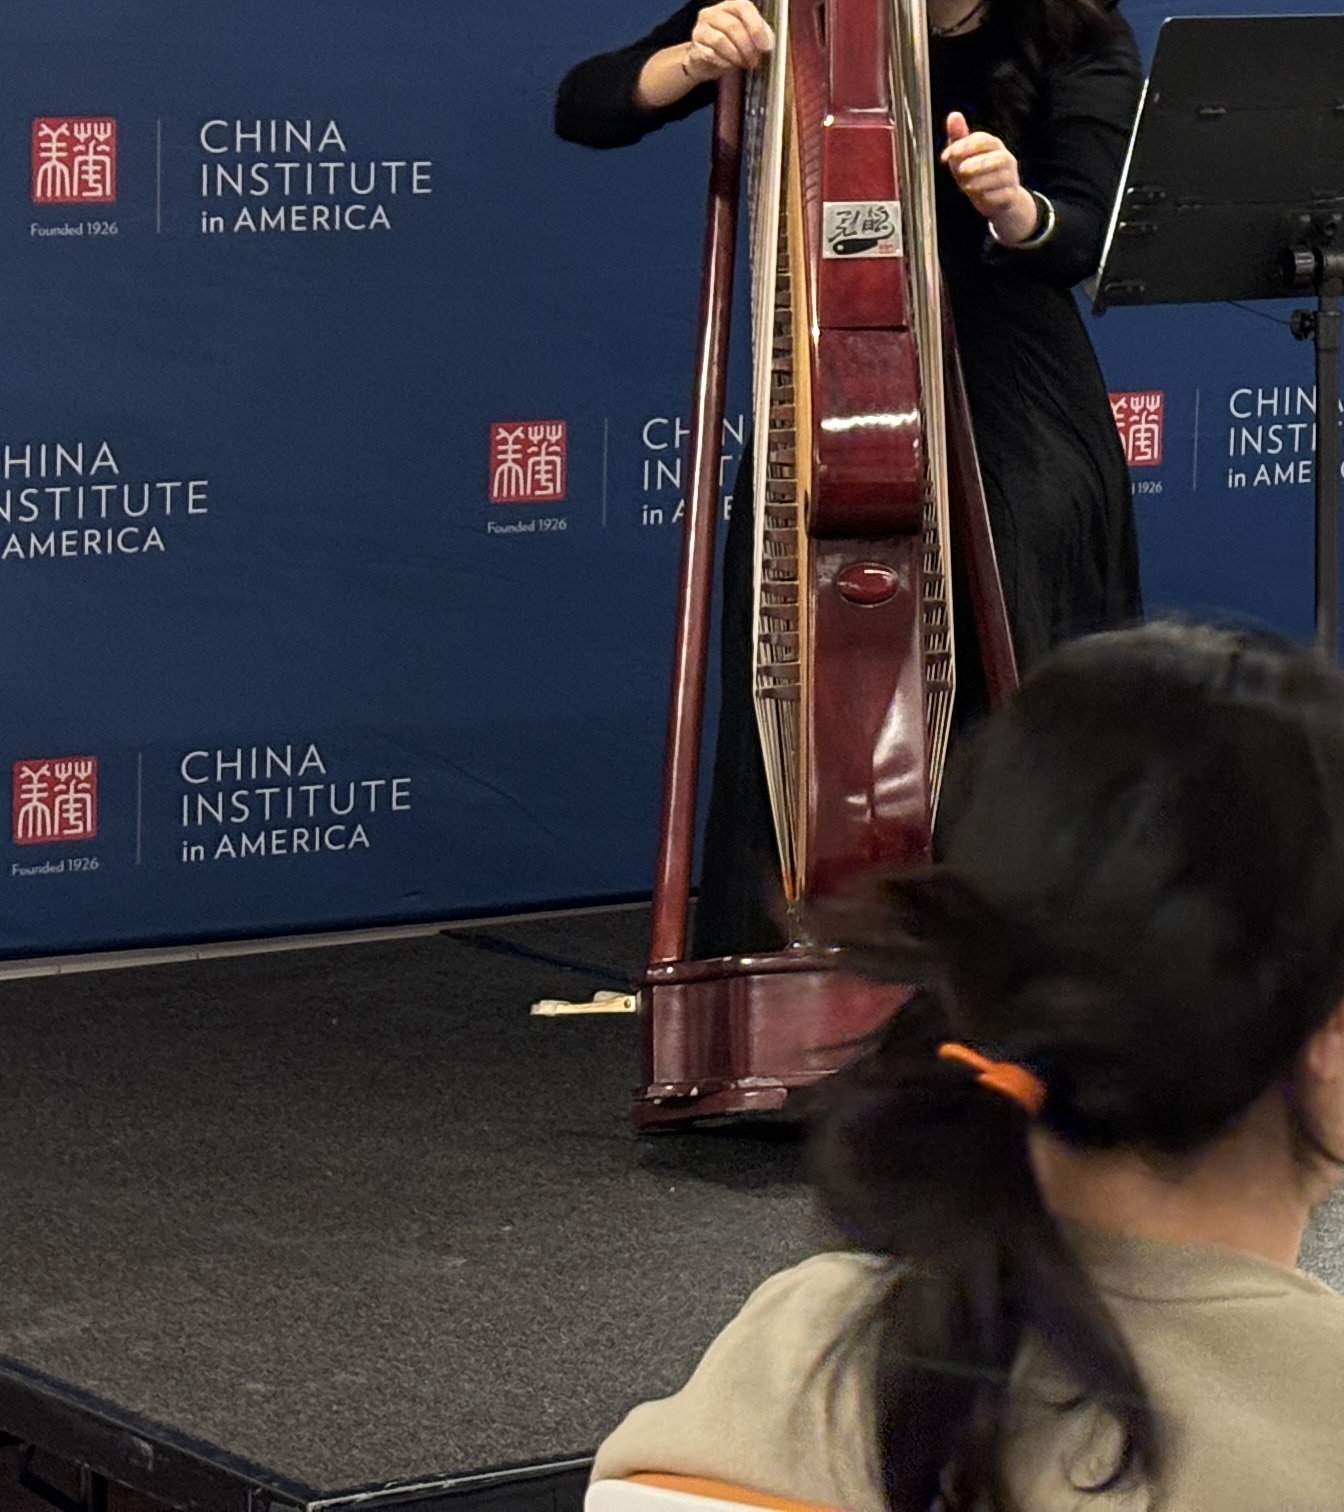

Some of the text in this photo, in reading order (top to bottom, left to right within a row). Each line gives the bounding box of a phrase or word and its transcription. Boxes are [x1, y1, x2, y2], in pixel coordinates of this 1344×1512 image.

[200, 119, 346, 154] CHINA
[202, 161, 432, 197] INSTITUTE
[31, 220, 120, 239] Founded 1926
[201, 204, 391, 234] in AMERICA
[1229, 385, 1344, 419] CHIN
[4, 441, 120, 480] HINA
[1138, 480, 1164, 496] 1926
[1228, 468, 1246, 489] in
[0, 480, 209, 523] STITUTE
[643, 504, 663, 525] in
[1, 526, 165, 560] AMERICA
[487, 517, 569, 535] Founded 1926
[181, 743, 327, 784] CHINA
[182, 777, 412, 827] INSTITUTE
[182, 823, 370, 863] in AMERICA
[12, 856, 101, 877] Founded 1926
